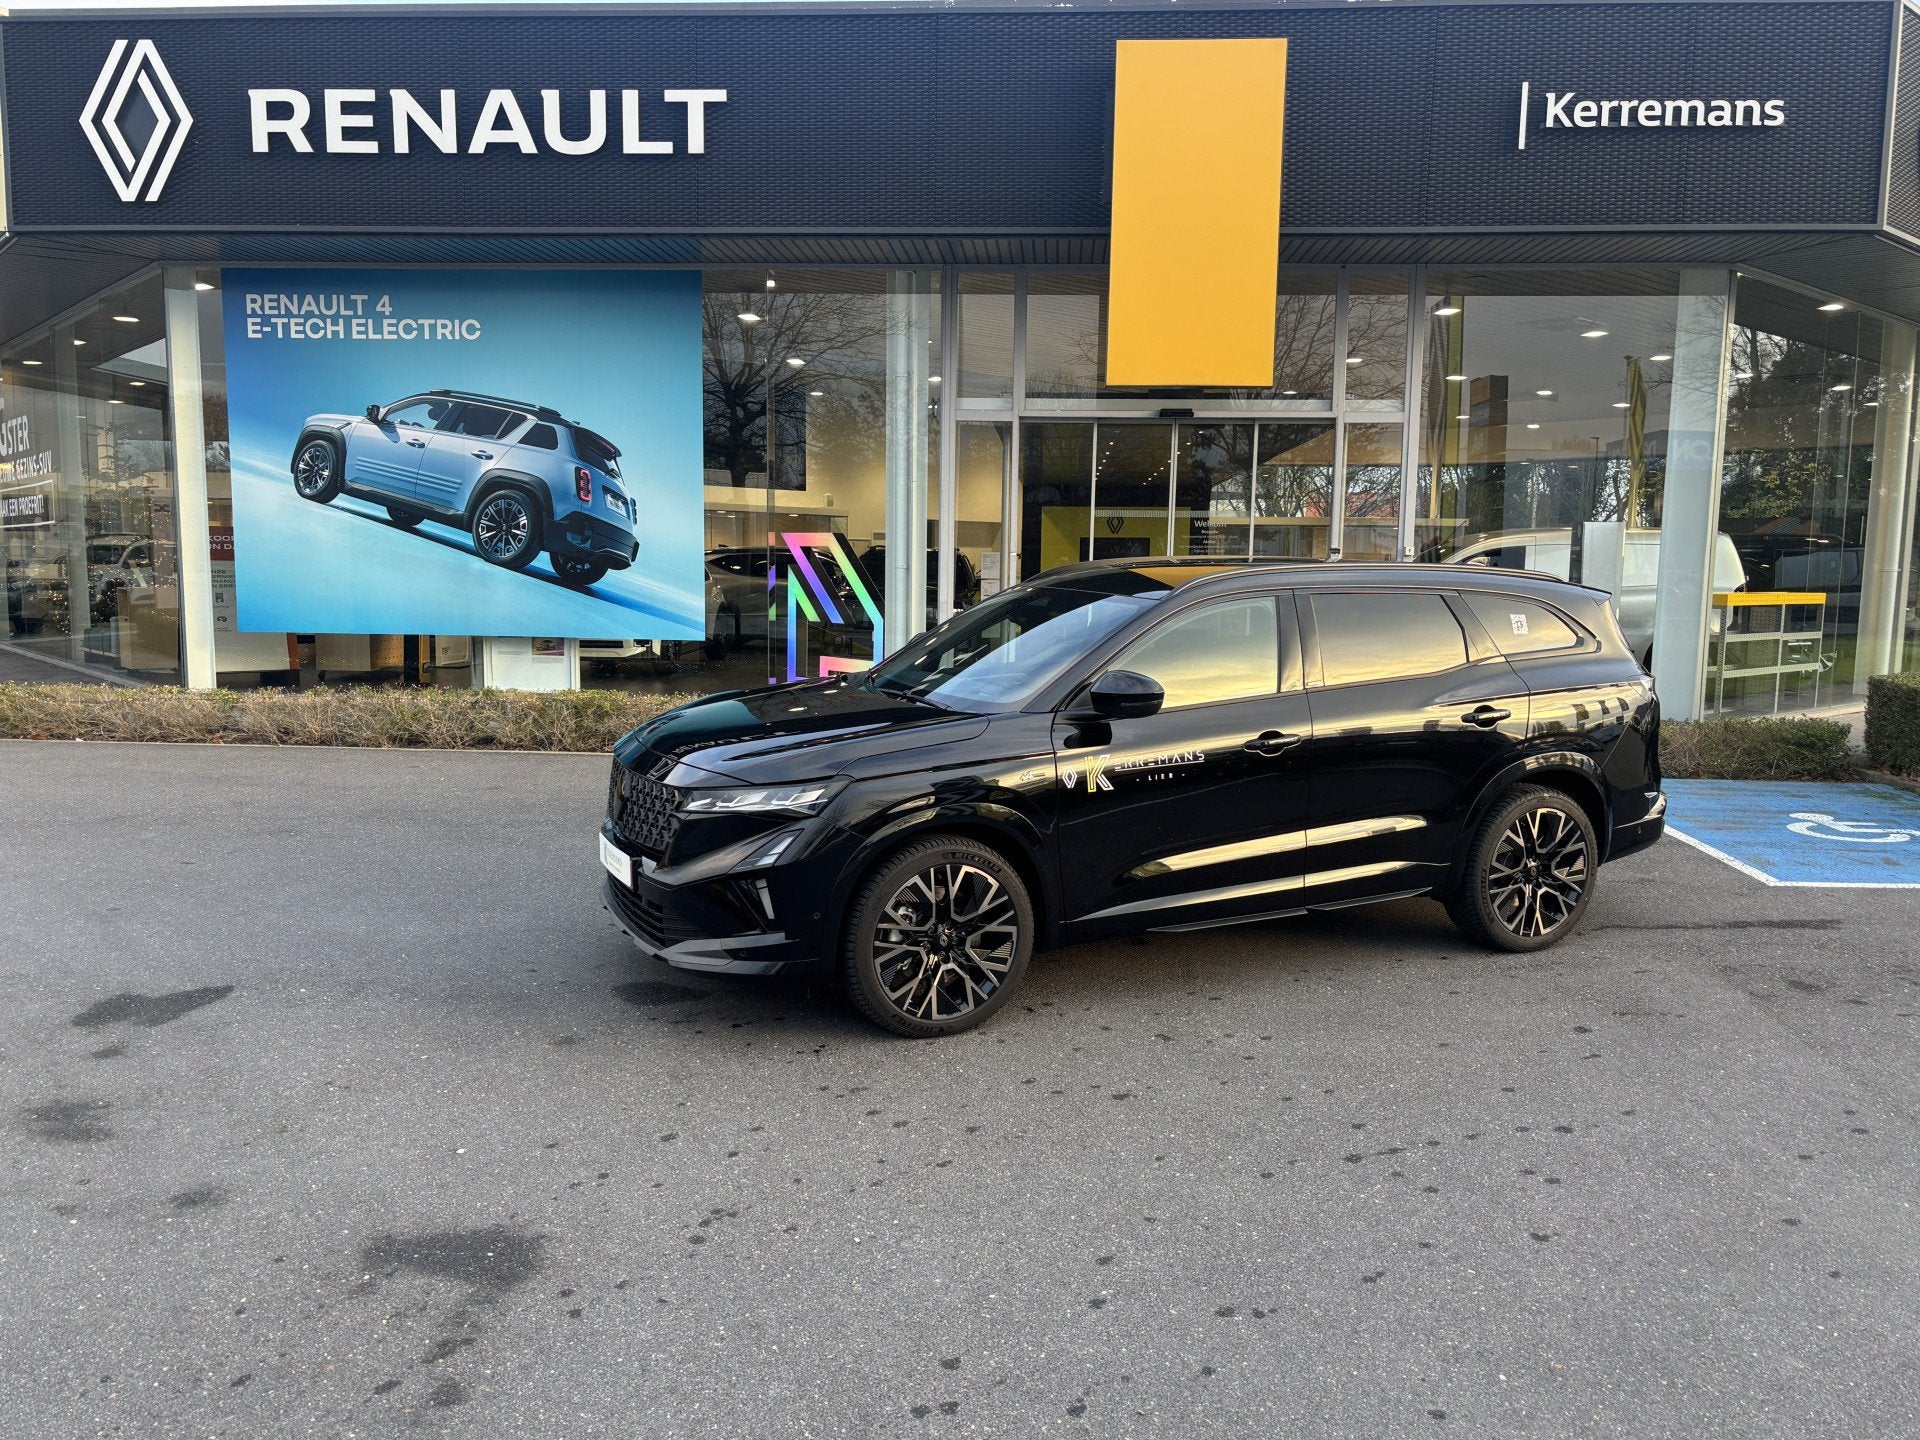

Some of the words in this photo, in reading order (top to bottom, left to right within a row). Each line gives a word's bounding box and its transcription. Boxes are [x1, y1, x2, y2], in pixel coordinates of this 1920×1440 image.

[248, 88, 728, 155] RENAULT
[1545, 92, 1786, 128] Kerremans
[245, 293, 368, 316] RENAULT
[375, 294, 393, 316] 4
[246, 317, 345, 339] E-TECH
[351, 318, 482, 340] ELECTRIC
[1148, 772, 1173, 782] LIER
